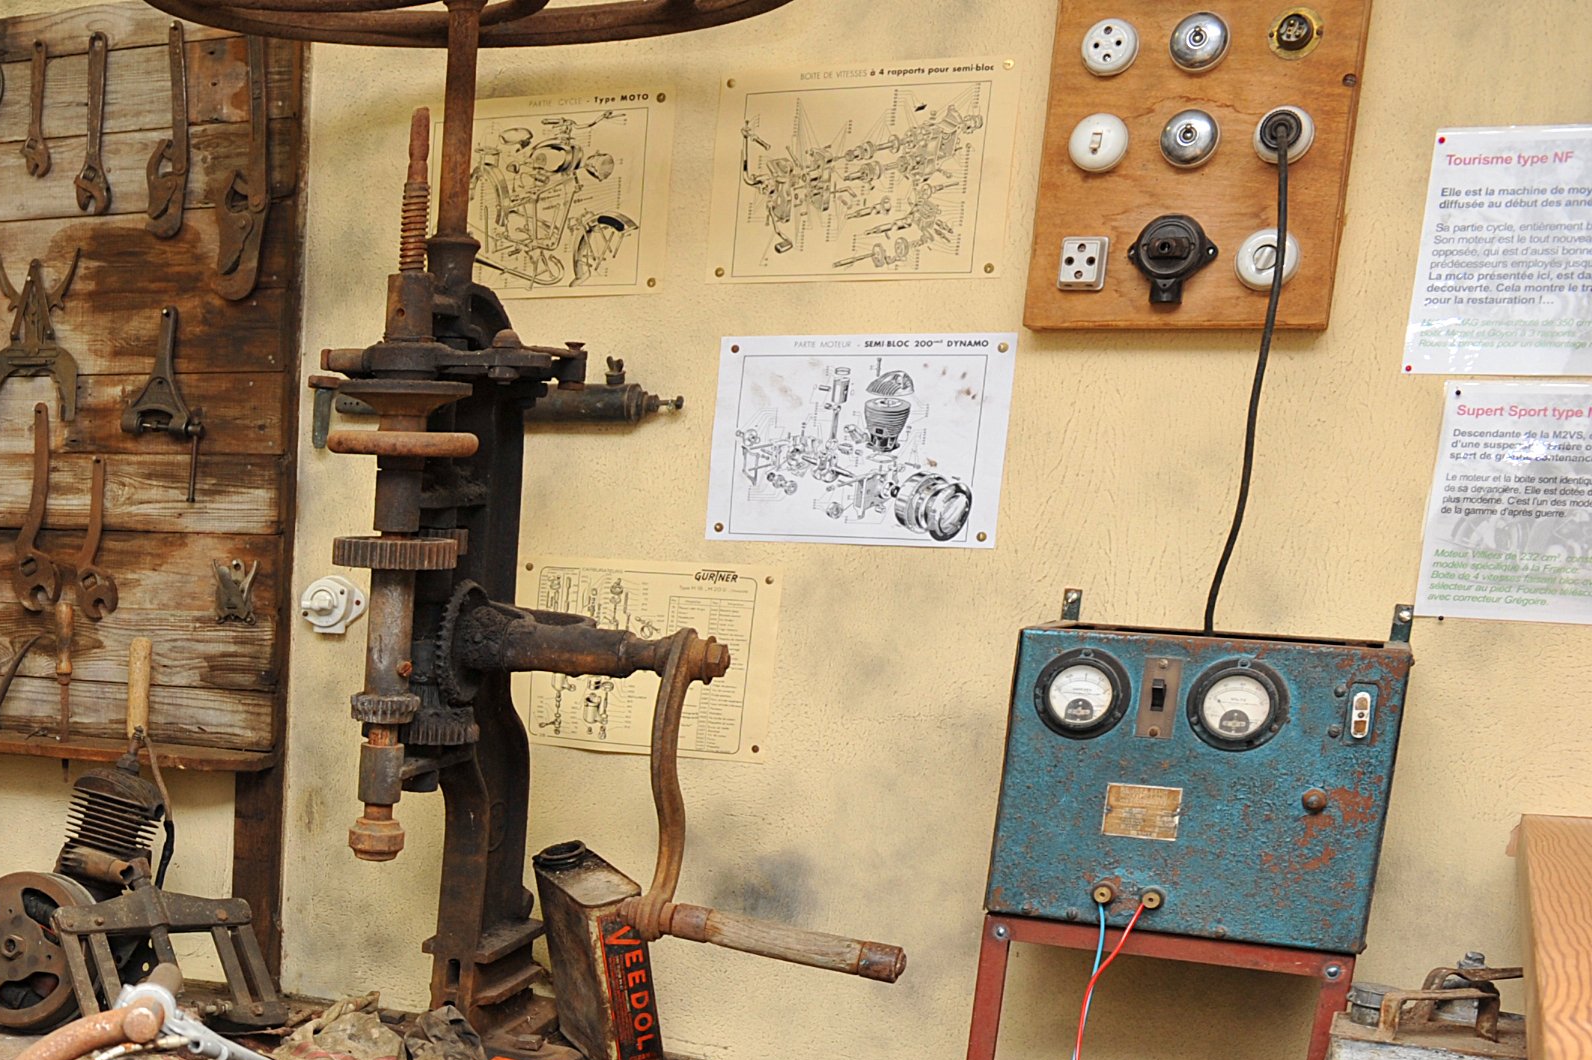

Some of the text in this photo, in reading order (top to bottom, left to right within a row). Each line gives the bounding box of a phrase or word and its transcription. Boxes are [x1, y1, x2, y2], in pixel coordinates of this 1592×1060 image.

[823, 71, 833, 79] DE
[836, 70, 868, 79] VITESSES
[878, 68, 885, 76] 4
[887, 67, 925, 77] rapports
[927, 66, 949, 75] pour
[594, 96, 616, 105] Type
[620, 93, 649, 102] MOTO
[1446, 150, 1575, 168] Tourisme type NF
[1441, 187, 1462, 197] Elle
[1465, 187, 1482, 197] est
[1485, 186, 1495, 196] la
[1498, 185, 1547, 196] machine
[1550, 185, 1565, 195] de
[1438, 197, 1562, 209] diffusée au début des
[1435, 223, 1450, 233] Sa
[1452, 223, 1483, 234] partie
[1485, 222, 1516, 233] cycle,
[1519, 221, 1584, 232] entièrement
[1433, 235, 1455, 245] Son
[1457, 235, 1495, 245] moteur
[1497, 235, 1515, 244] est
[1517, 235, 1527, 244] le
[1529, 235, 1550, 244] tout
[1431, 247, 1480, 258] opposée,
[1483, 247, 1499, 257] qui
[1502, 247, 1519, 256] est
[1521, 246, 1559, 256] d'aussi
[1430, 259, 1562, 270] prédécesseurs employés
[1428, 270, 1574, 282] La moto présentée ici, est
[1495, 283, 1521, 293] Cela
[1523, 284, 1565, 293] montre
[1567, 283, 1578, 292] le
[1424, 295, 1536, 307] pour la restauration
[947, 340, 989, 348] DYNAMO
[1456, 404, 1584, 420] Supert Sport type
[1453, 429, 1521, 438] Descendante
[1540, 430, 1550, 439] la
[1552, 431, 1586, 441] M2VS,
[1451, 440, 1480, 450] d'une
[1445, 473, 1457, 482] Le
[1459, 473, 1490, 483] moteur
[1492, 474, 1501, 483] et
[1503, 474, 1512, 483] la
[1537, 475, 1557, 484] sont
[1444, 484, 1456, 493] de
[1458, 485, 1468, 493] sa
[1524, 485, 1541, 495] Elle
[1543, 487, 1557, 496] est
[1442, 496, 1460, 506] plus
[1507, 496, 1530, 506] C'est
[1532, 497, 1548, 506] l'un
[1550, 497, 1567, 507] des
[1440, 505, 1453, 514] de
[1454, 506, 1462, 515] la
[1464, 508, 1498, 517] gamme
[1500, 507, 1533, 519] d'après
[1520, 552, 1539, 561] 232
[694, 569, 739, 584] GURTNER
[605, 925, 656, 1051] VEEDOL
